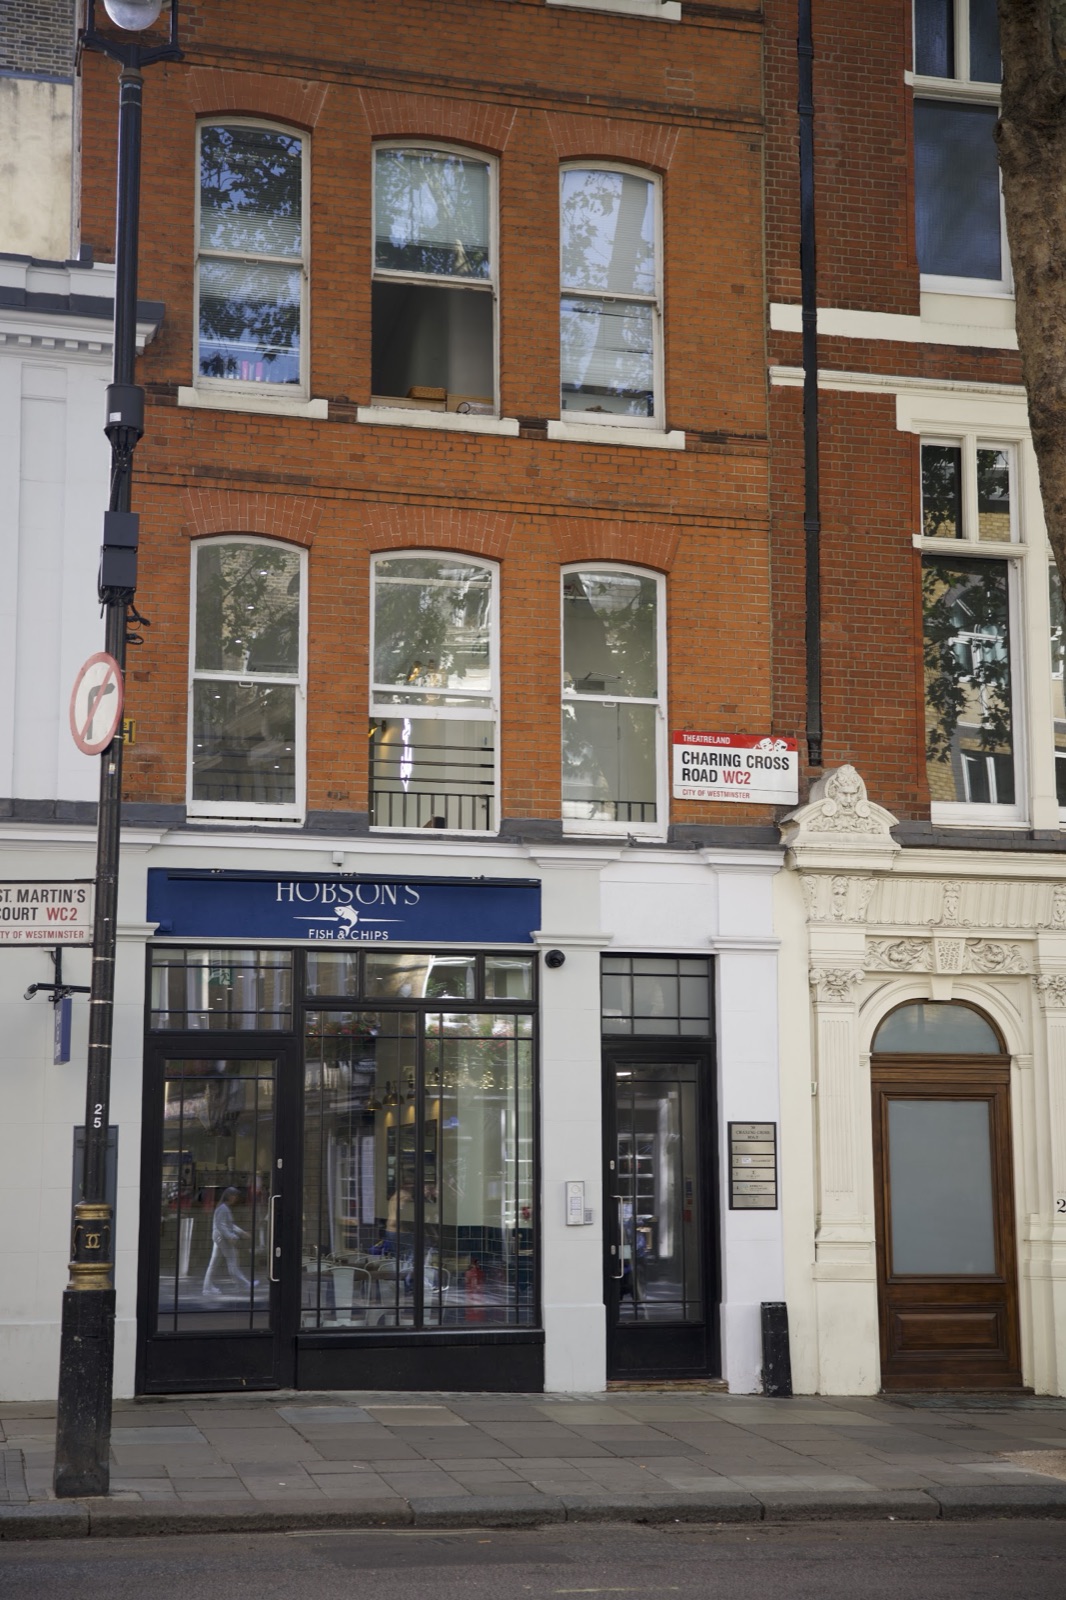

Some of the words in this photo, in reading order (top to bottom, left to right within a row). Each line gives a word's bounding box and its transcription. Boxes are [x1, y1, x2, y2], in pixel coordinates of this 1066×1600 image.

[682, 734, 731, 744] THEATRELAND
[682, 751, 741, 767] CHARING
[746, 755, 790, 770] CROSS
[682, 768, 718, 782] ROAD
[723, 770, 751, 784] WC2
[707, 790, 750, 799] WESTMINSTER
[17, 889, 86, 903] MARTIN'S
[276, 882, 420, 905] HOBSONS
[0, 907, 38, 921] OURT
[46, 907, 78, 921] WC2
[0, 931, 10, 939] TY
[13, 931, 23, 939] OF
[26, 930, 84, 939] WESTMINSTER
[308, 929, 334, 939] FISH
[350, 930, 389, 940] CHIPS
